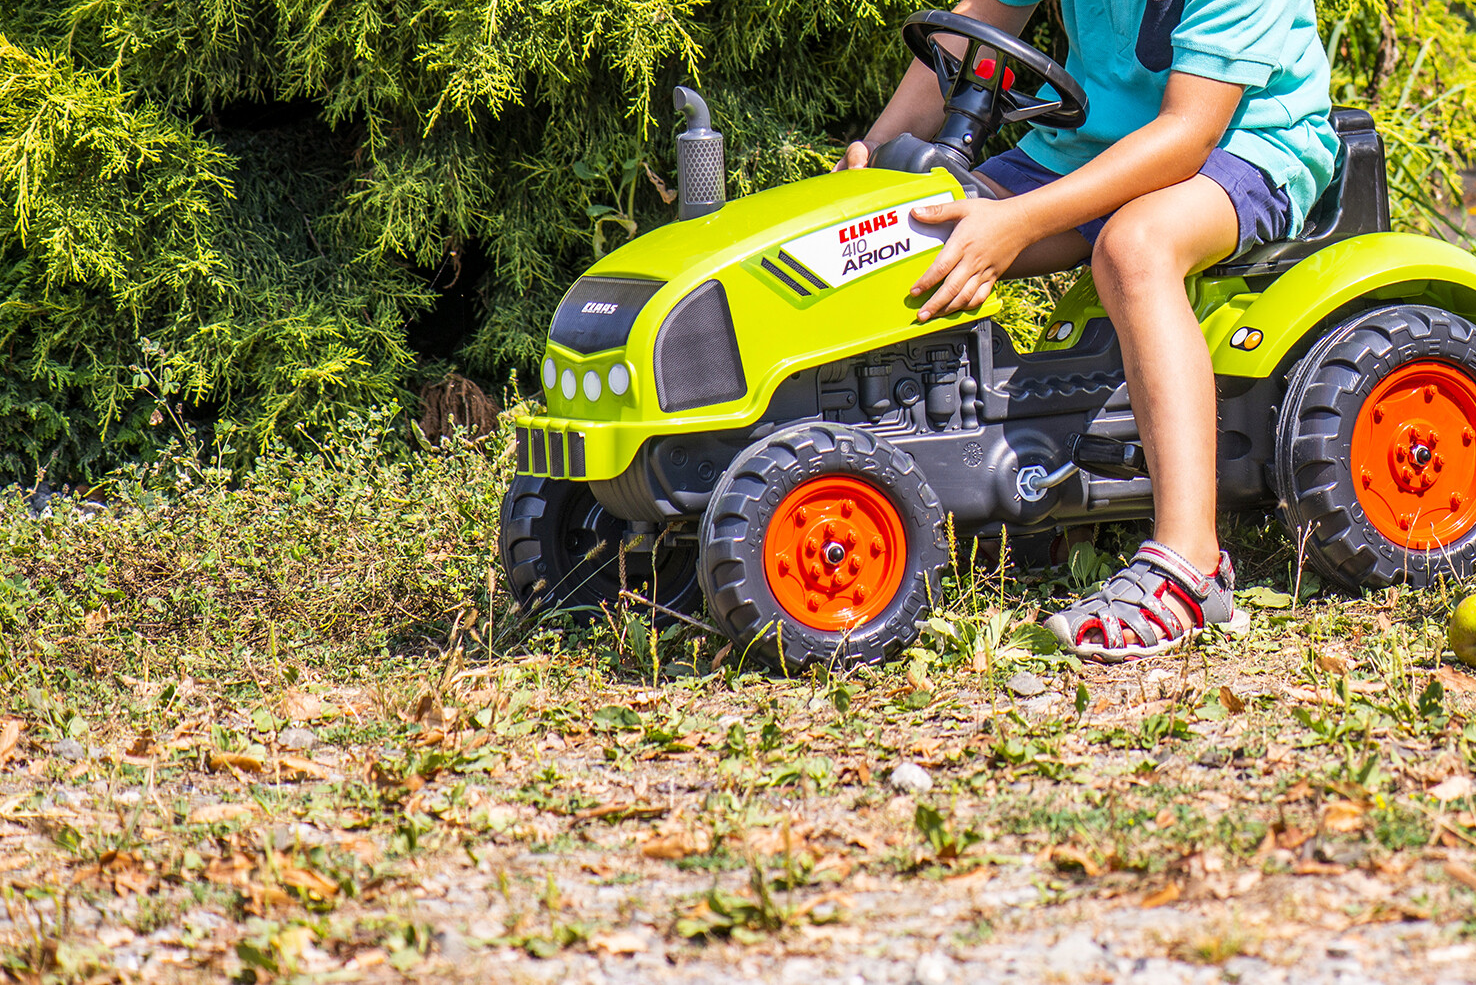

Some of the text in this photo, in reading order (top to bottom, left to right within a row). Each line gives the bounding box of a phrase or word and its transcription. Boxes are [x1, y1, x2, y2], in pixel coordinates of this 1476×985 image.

[839, 211, 898, 243] CLAAS
[842, 238, 867, 257] 410
[842, 238, 910, 276] ARION
[581, 302, 618, 314] CLAAS
[840, 453, 896, 486] R28
